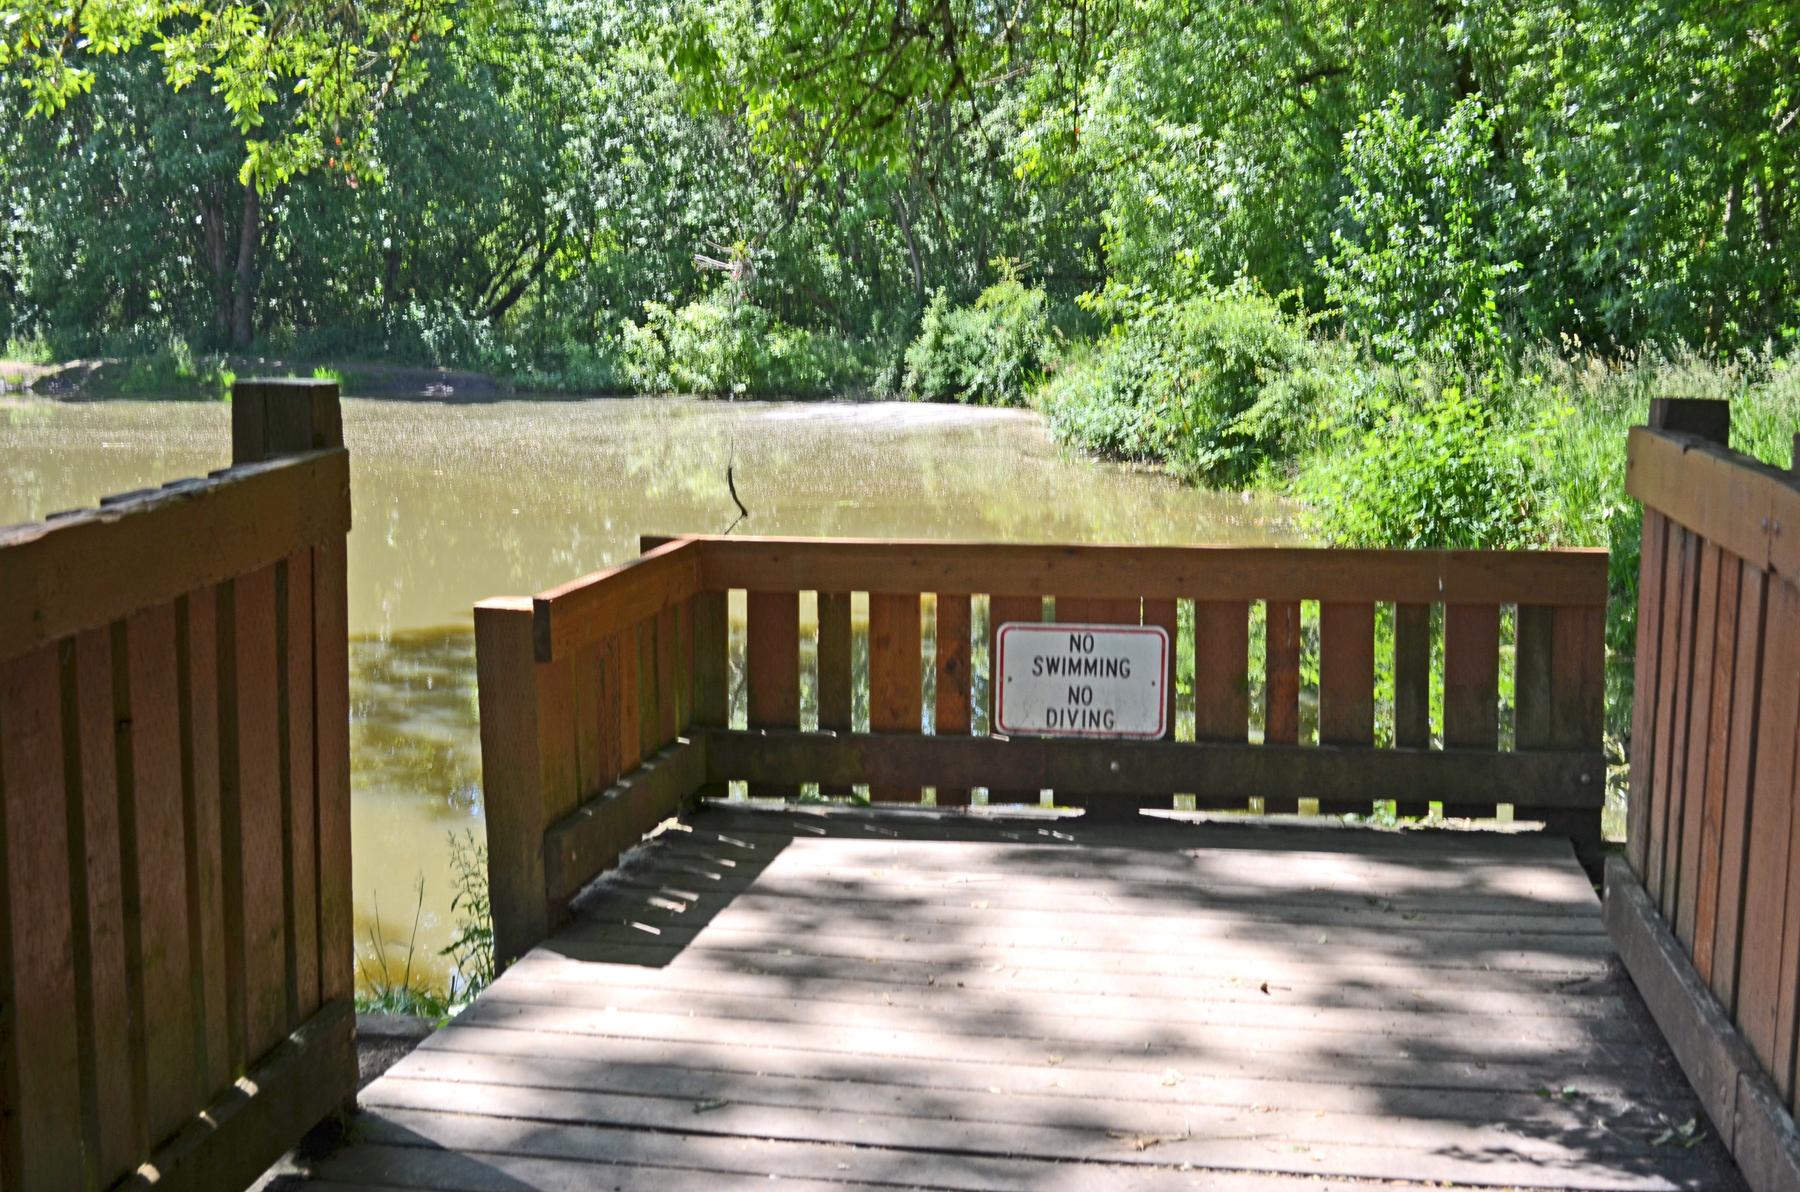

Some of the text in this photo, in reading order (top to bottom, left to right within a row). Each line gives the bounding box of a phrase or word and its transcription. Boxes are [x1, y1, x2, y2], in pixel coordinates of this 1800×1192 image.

[1069, 633, 1095, 654] NO
[1032, 655, 1131, 679] SWIMMING
[1067, 685, 1093, 706] NO
[1046, 706, 1115, 730] DIVING
